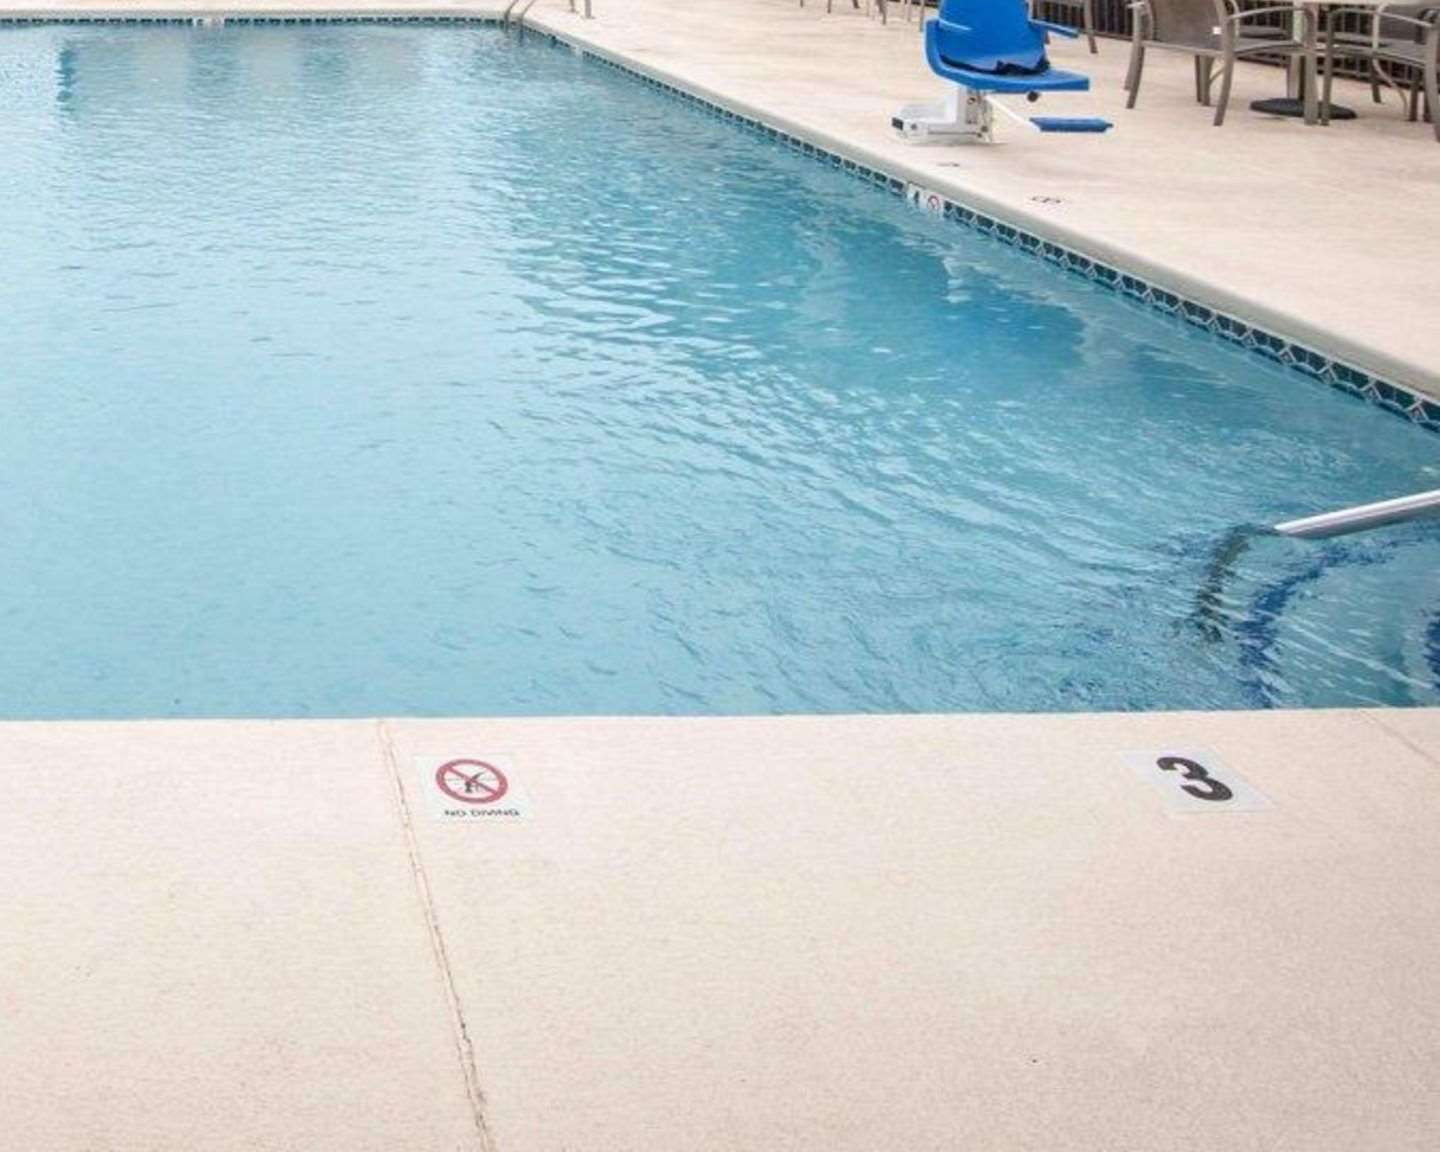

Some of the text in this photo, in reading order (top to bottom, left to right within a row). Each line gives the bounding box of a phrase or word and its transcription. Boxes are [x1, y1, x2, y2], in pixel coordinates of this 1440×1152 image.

[1156, 756, 1233, 802] 3
[444, 808, 520, 817] NO DIVING
